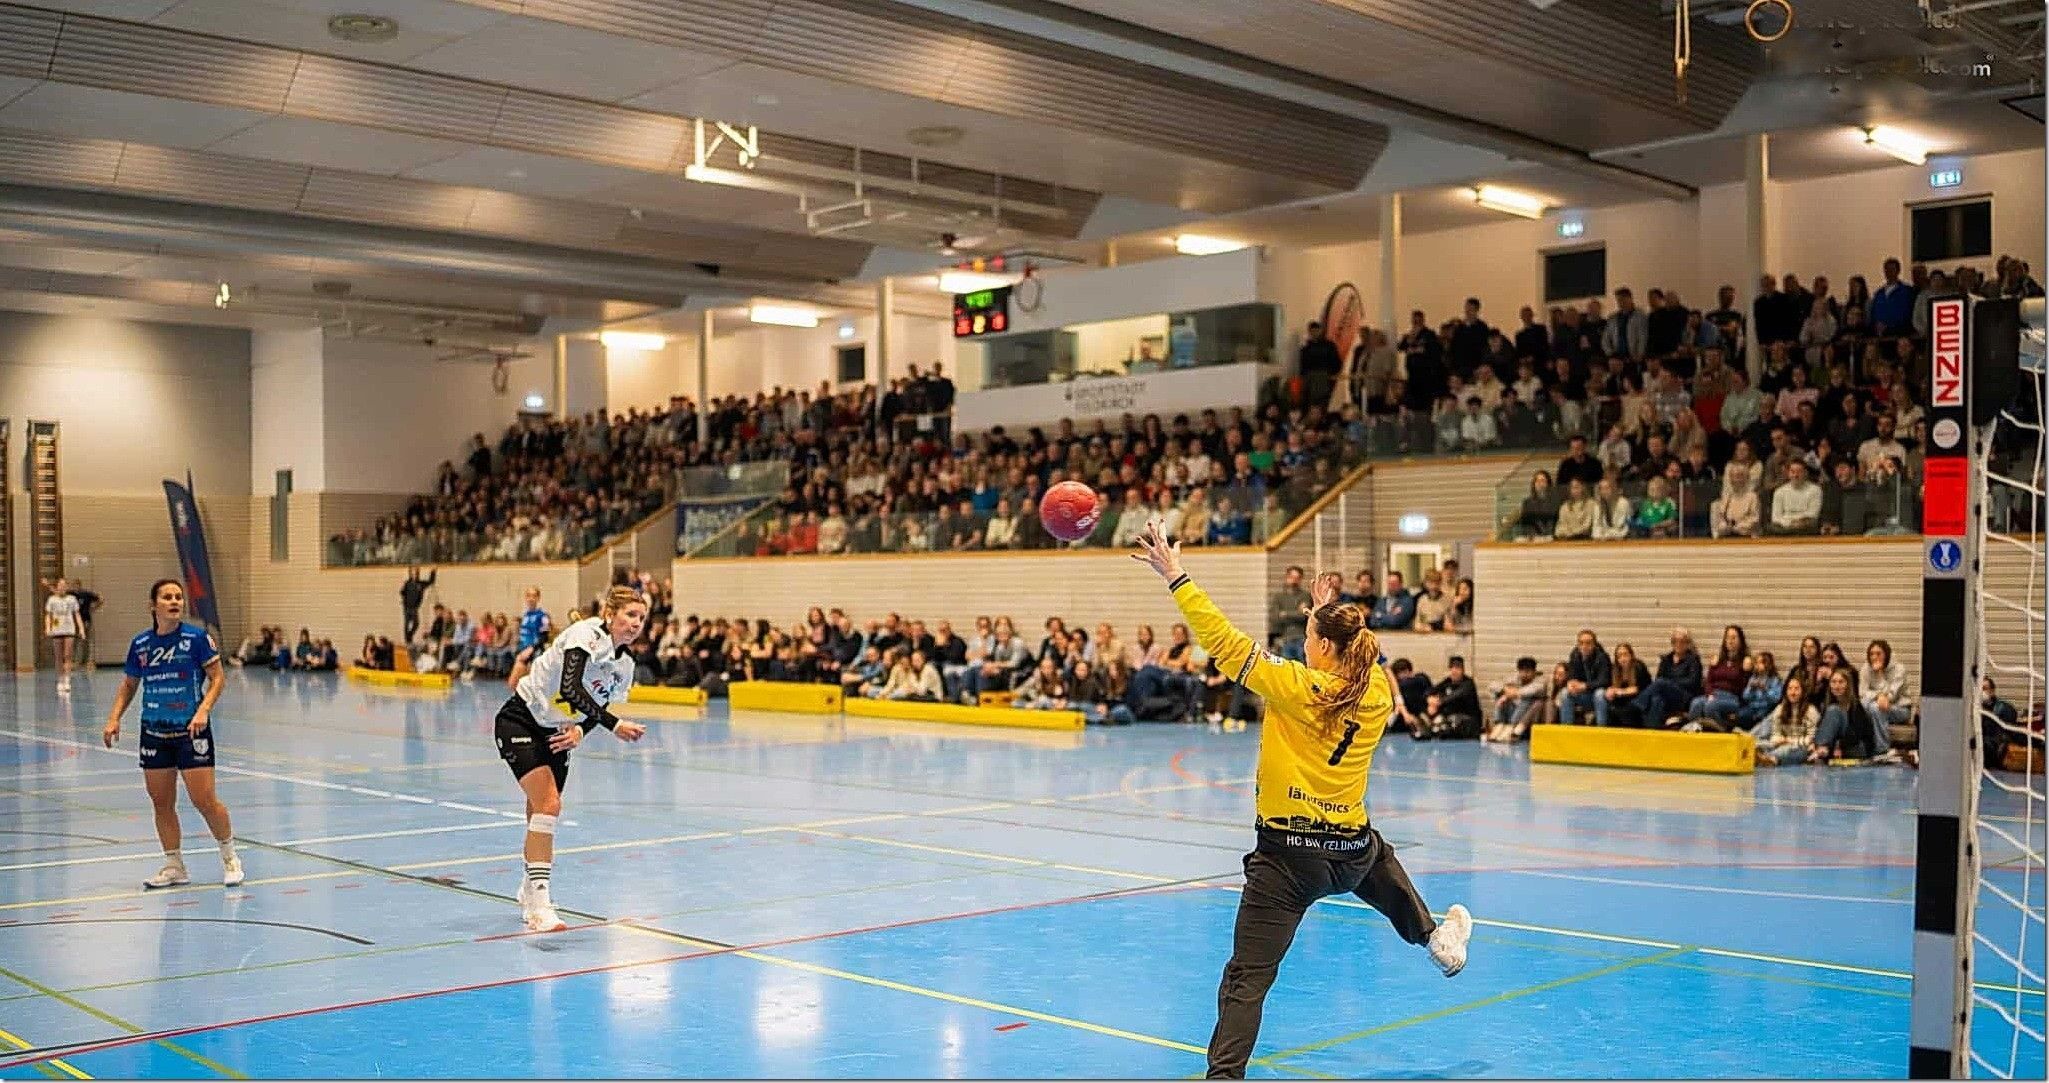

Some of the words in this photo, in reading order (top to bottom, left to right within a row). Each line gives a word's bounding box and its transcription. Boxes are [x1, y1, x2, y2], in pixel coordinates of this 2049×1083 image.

[1936, 304, 1960, 403] BENZ
[149, 646, 176, 667] 24
[1286, 834, 1302, 847] HC
